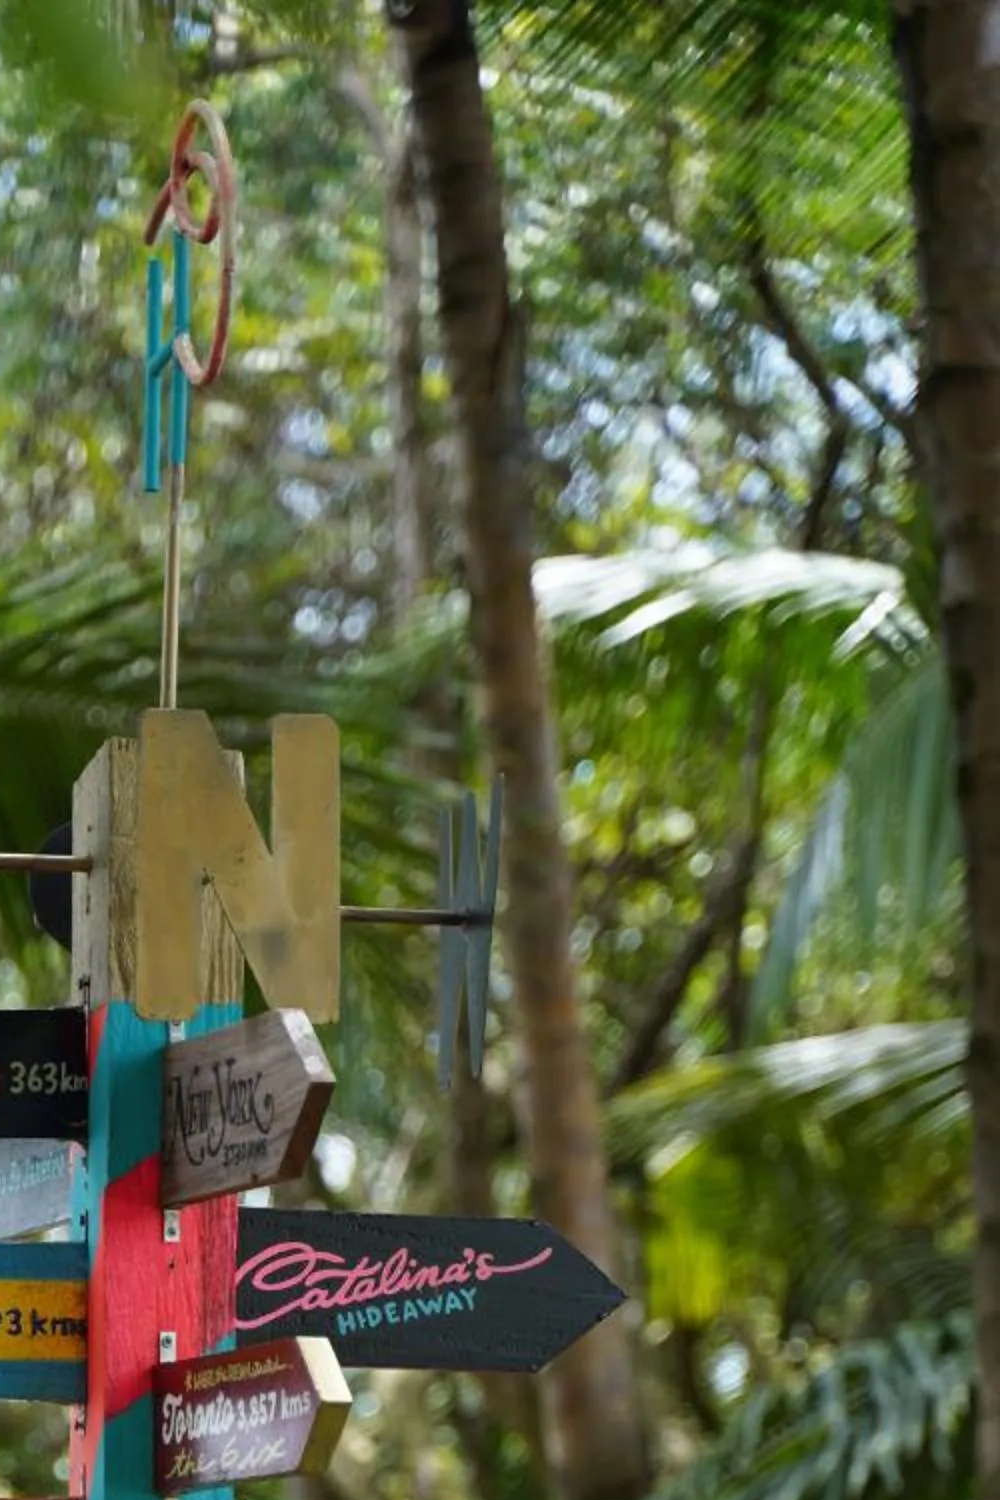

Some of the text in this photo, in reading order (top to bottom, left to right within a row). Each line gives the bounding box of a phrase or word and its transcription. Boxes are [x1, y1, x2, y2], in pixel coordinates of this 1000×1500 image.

[8, 1061, 58, 1094] 363
[236, 1242, 553, 1330] Catalina's
[336, 1288, 477, 1336] HIDEAWAY
[162, 1391, 236, 1446] Toronto
[281, 1390, 311, 1419] kms
[165, 1447, 217, 1479] the
